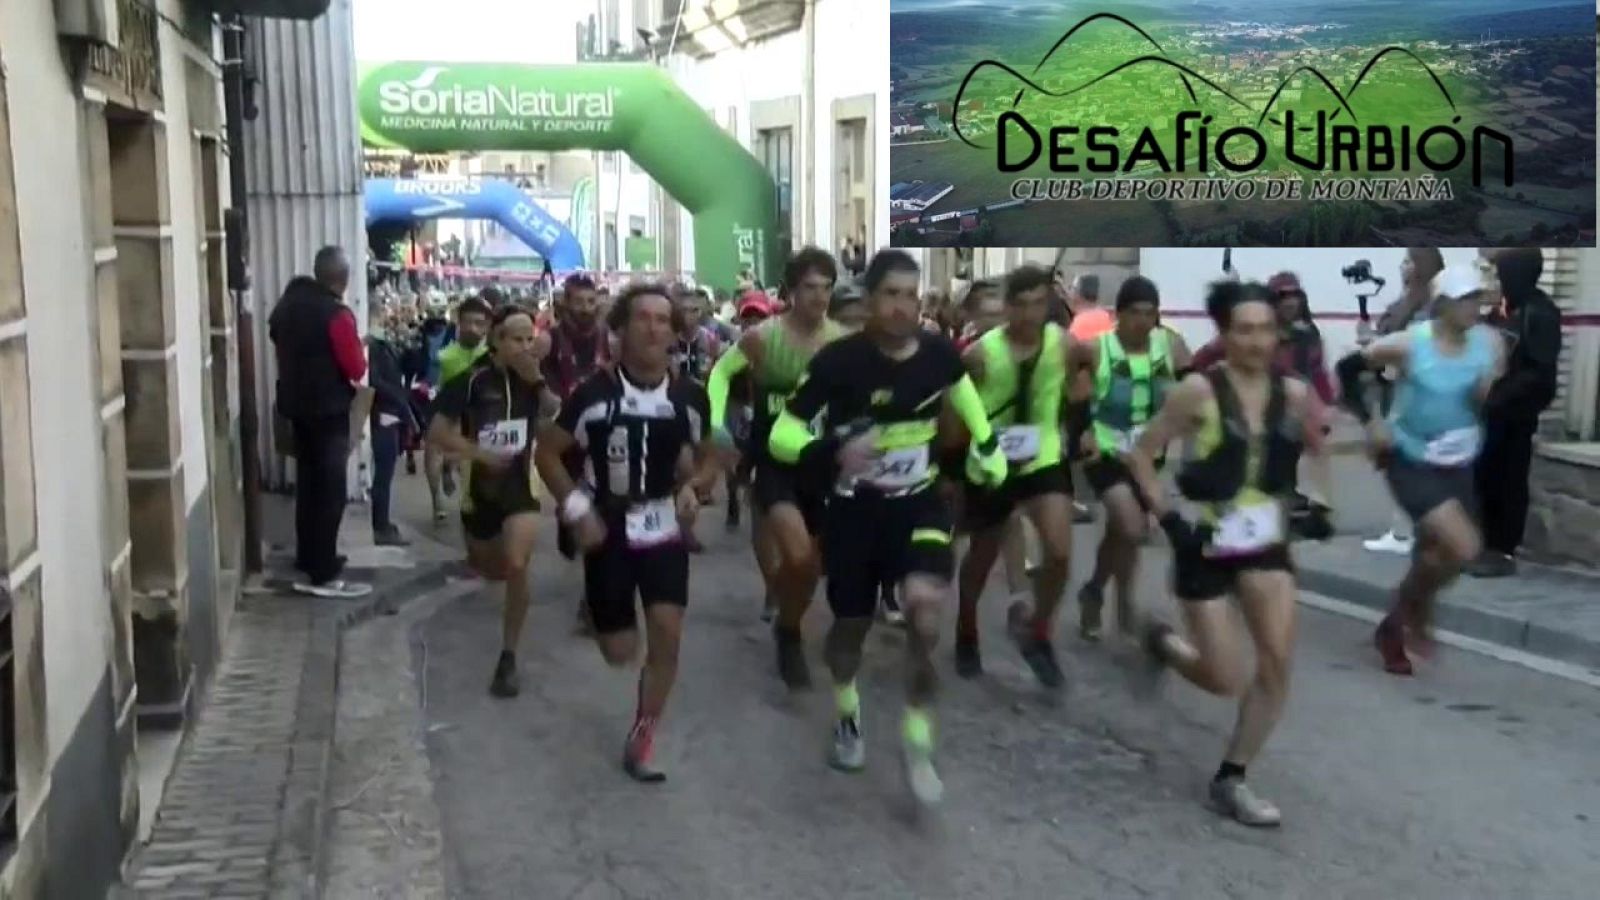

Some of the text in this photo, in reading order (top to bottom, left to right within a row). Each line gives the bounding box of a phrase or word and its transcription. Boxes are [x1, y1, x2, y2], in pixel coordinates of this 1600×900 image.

[379, 78, 614, 118] SoriaNatural
[380, 115, 615, 133] MEDICINA NATURAL Y DEPORTE
[393, 179, 481, 196] BROOKS
